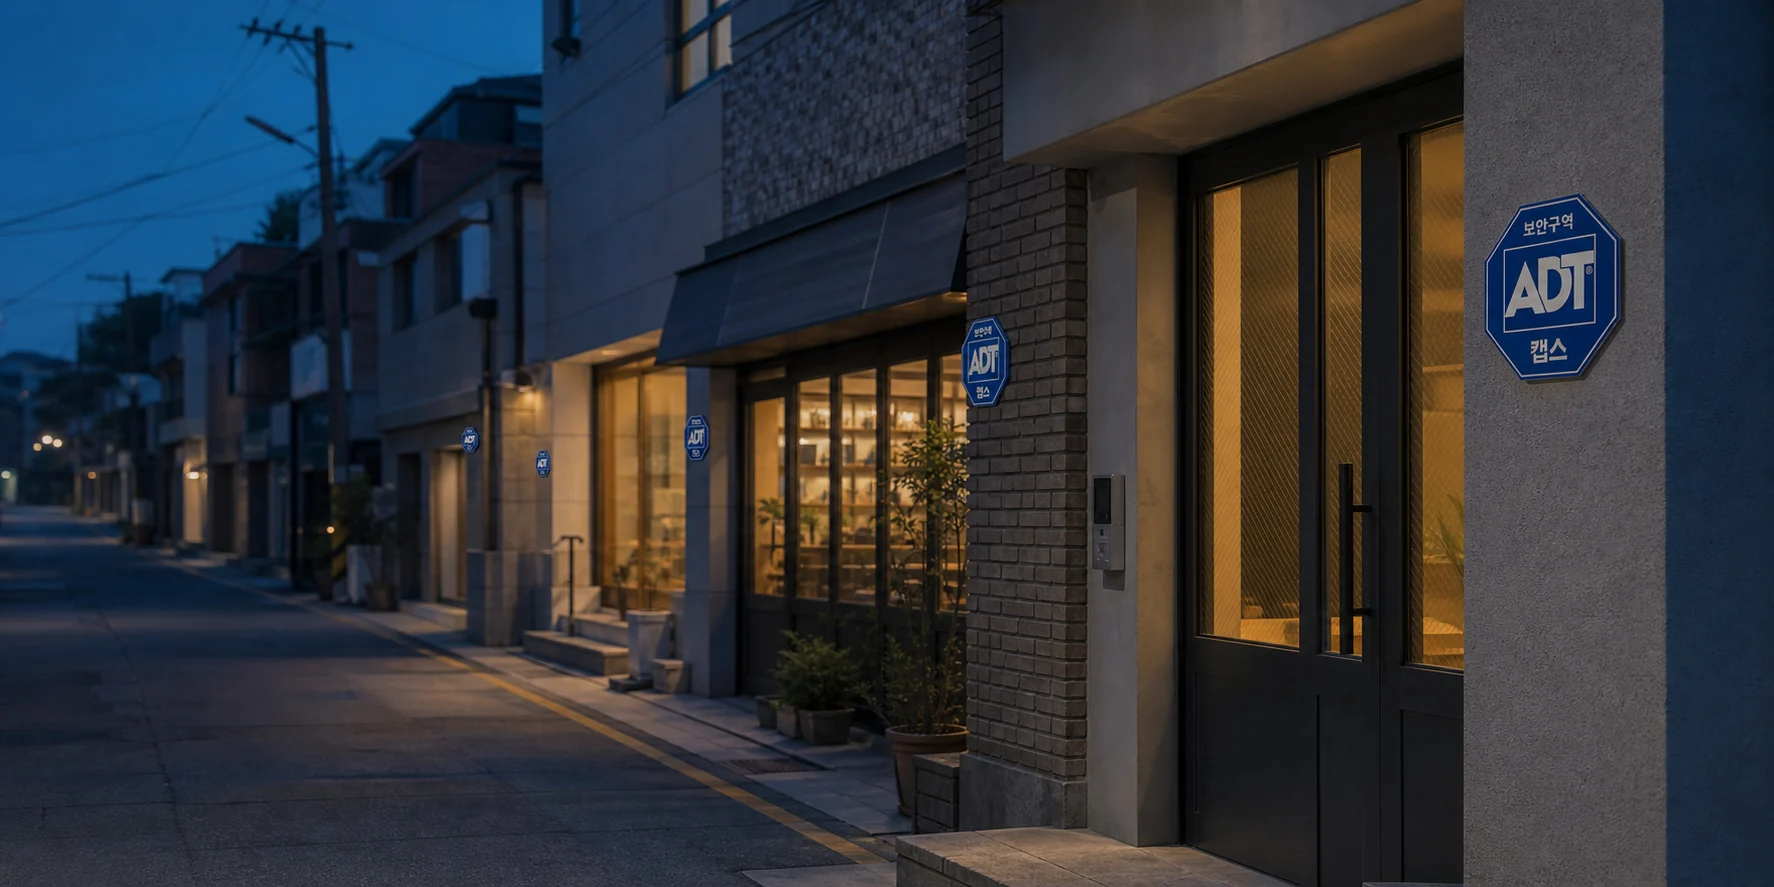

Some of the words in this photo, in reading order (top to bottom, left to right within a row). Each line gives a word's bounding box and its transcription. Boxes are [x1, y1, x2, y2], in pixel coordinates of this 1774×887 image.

[1523, 213, 1573, 236] 보안구역
[1504, 250, 1594, 318] ADT
[968, 344, 999, 376] ADT
[1530, 338, 1568, 364] 캡스
